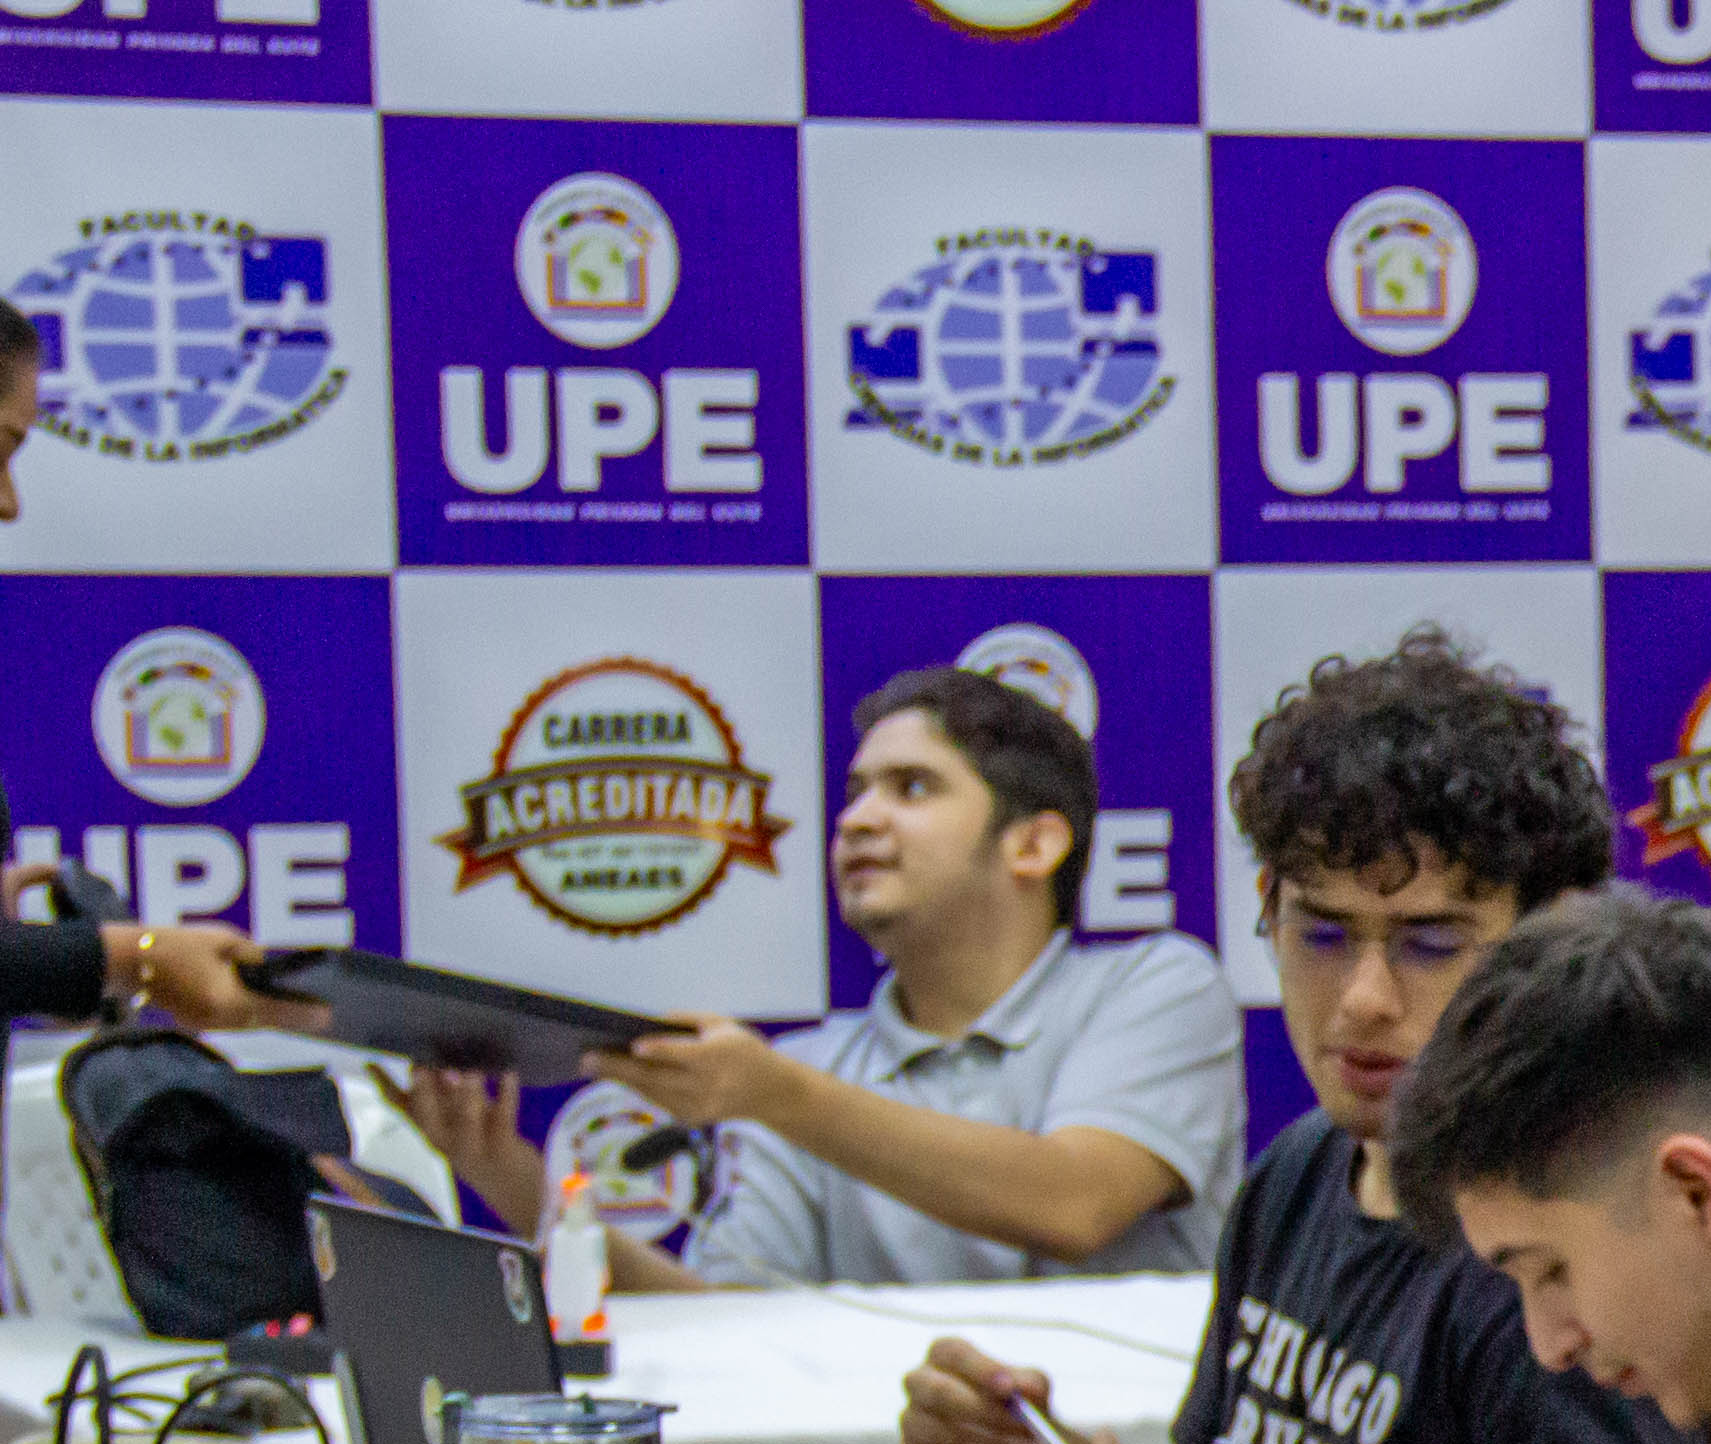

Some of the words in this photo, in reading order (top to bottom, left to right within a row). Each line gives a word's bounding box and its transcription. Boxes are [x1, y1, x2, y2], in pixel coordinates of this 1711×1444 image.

[78, 211, 256, 239] FACULTAD
[440, 365, 763, 494] UPE
[1257, 371, 1553, 495] UPE
[144, 441, 179, 461] LA
[992, 449, 1023, 467] LA
[544, 713, 692, 750] CARRERA
[487, 774, 752, 843] ACREDITADA
